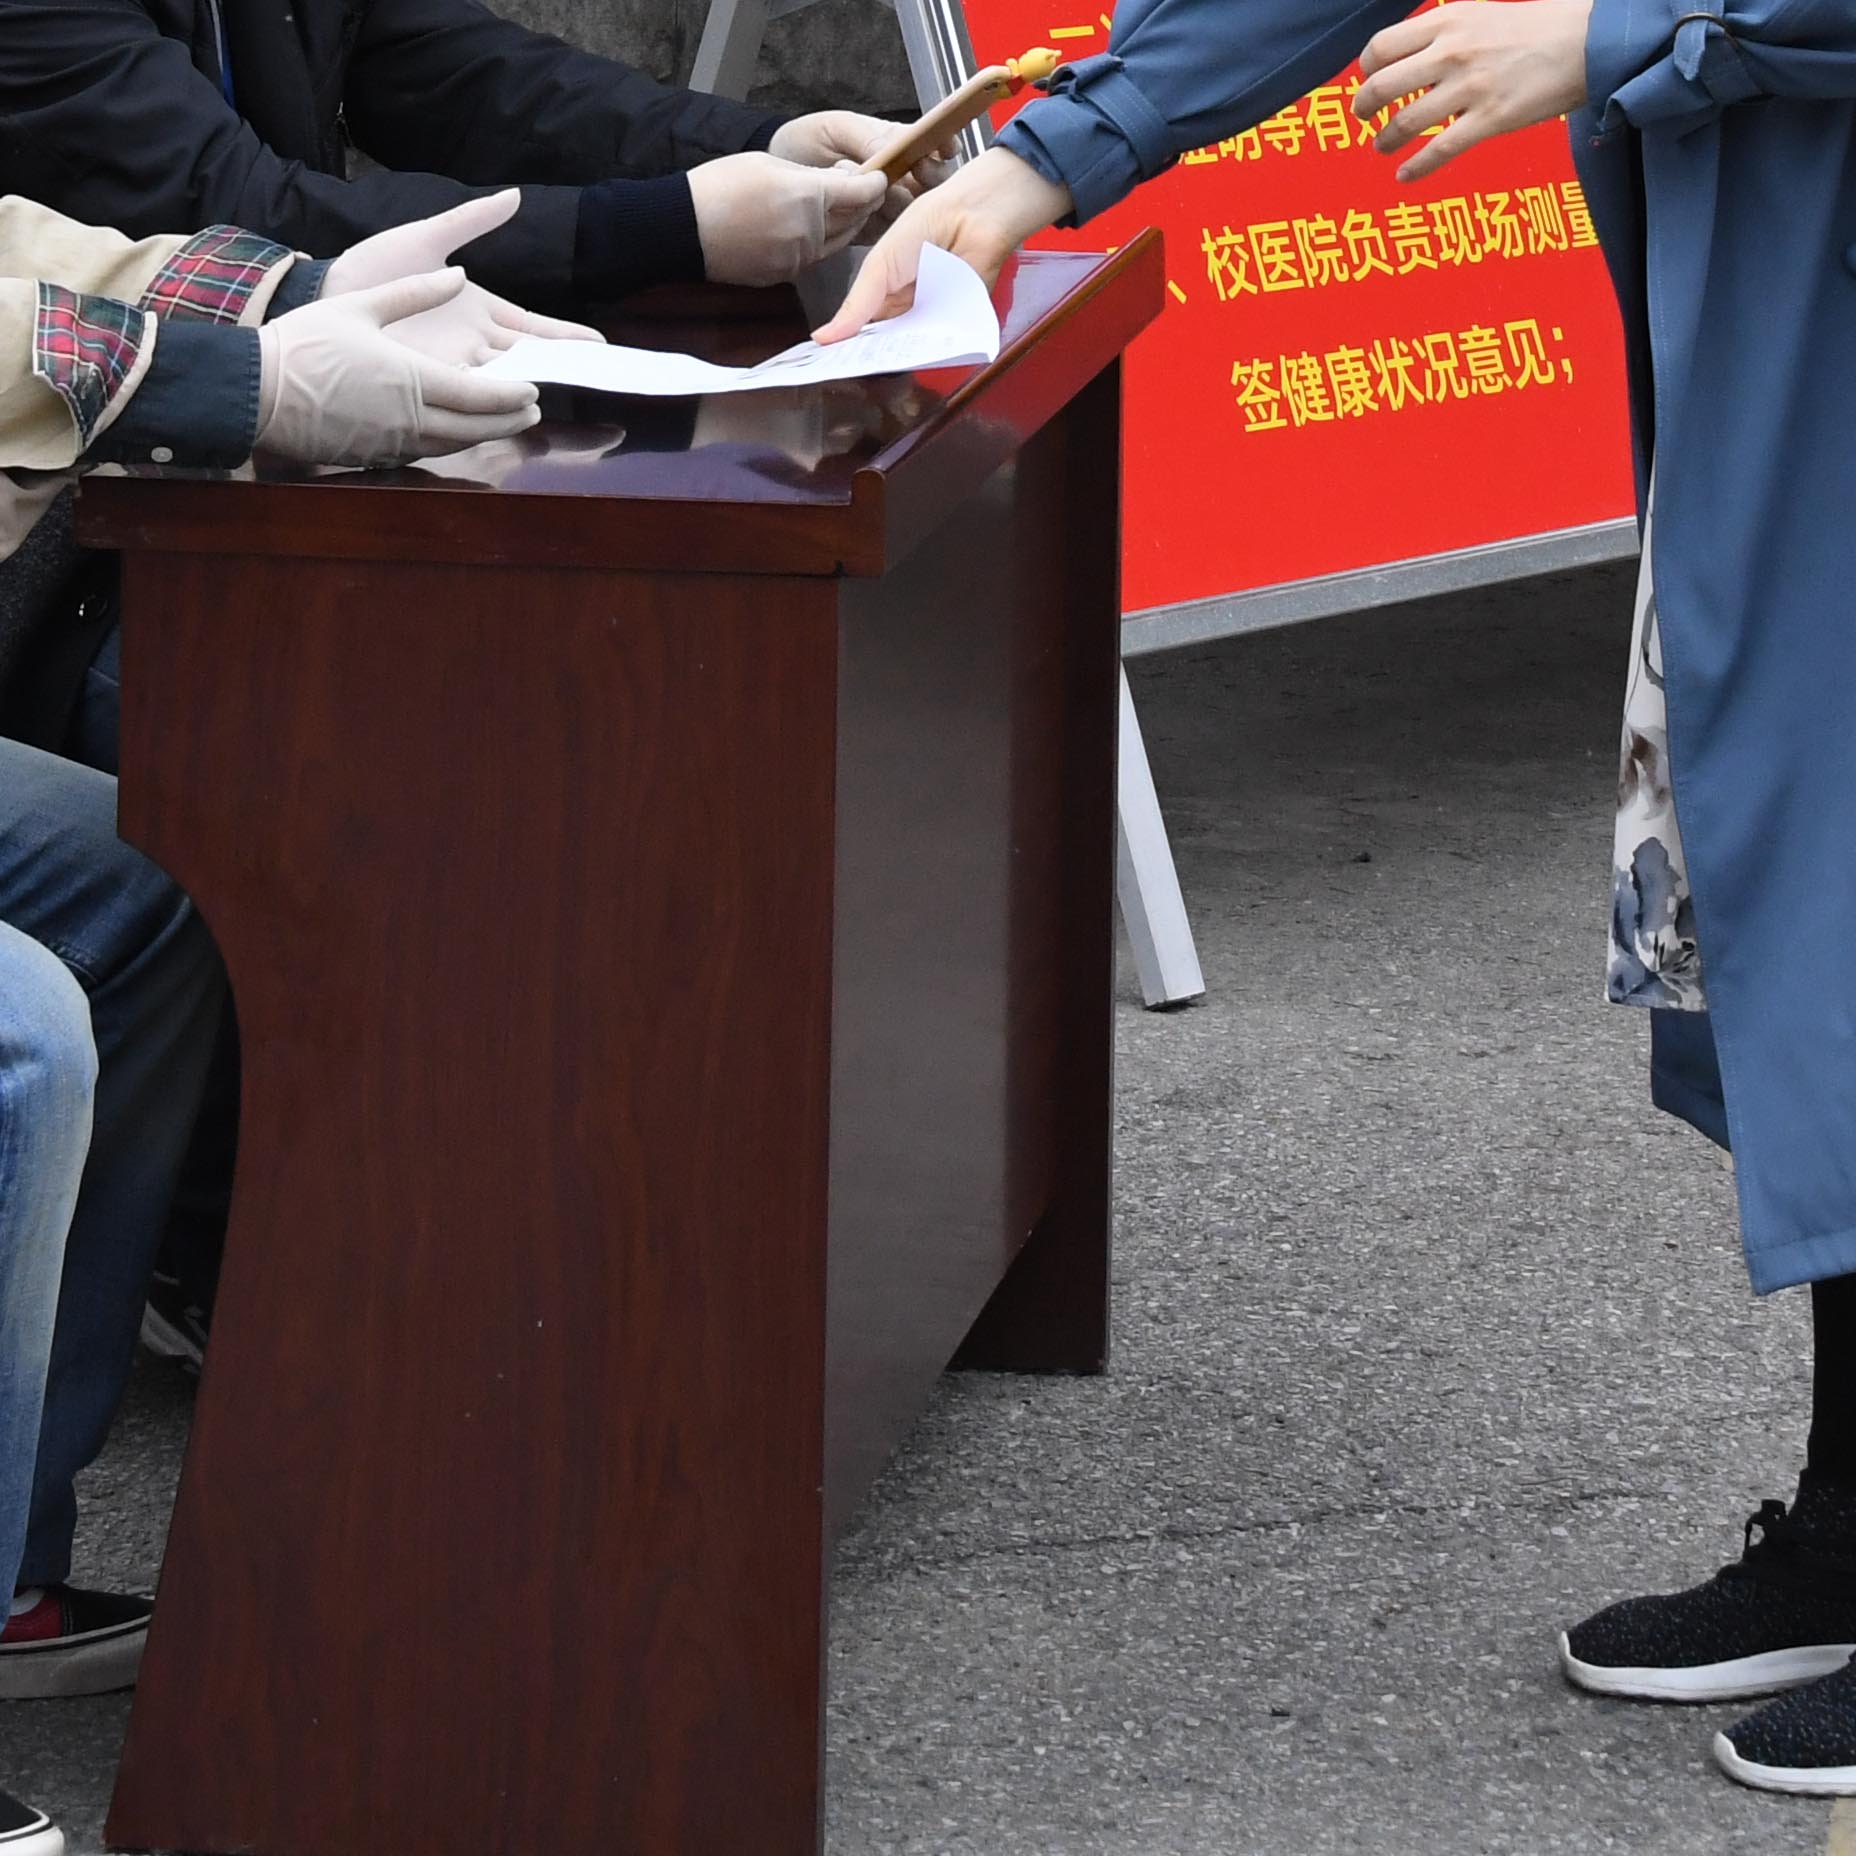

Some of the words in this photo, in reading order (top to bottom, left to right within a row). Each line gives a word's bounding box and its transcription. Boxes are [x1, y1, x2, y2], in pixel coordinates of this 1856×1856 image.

[1106, 180, 1600, 304] 、校医院负责现场测量
